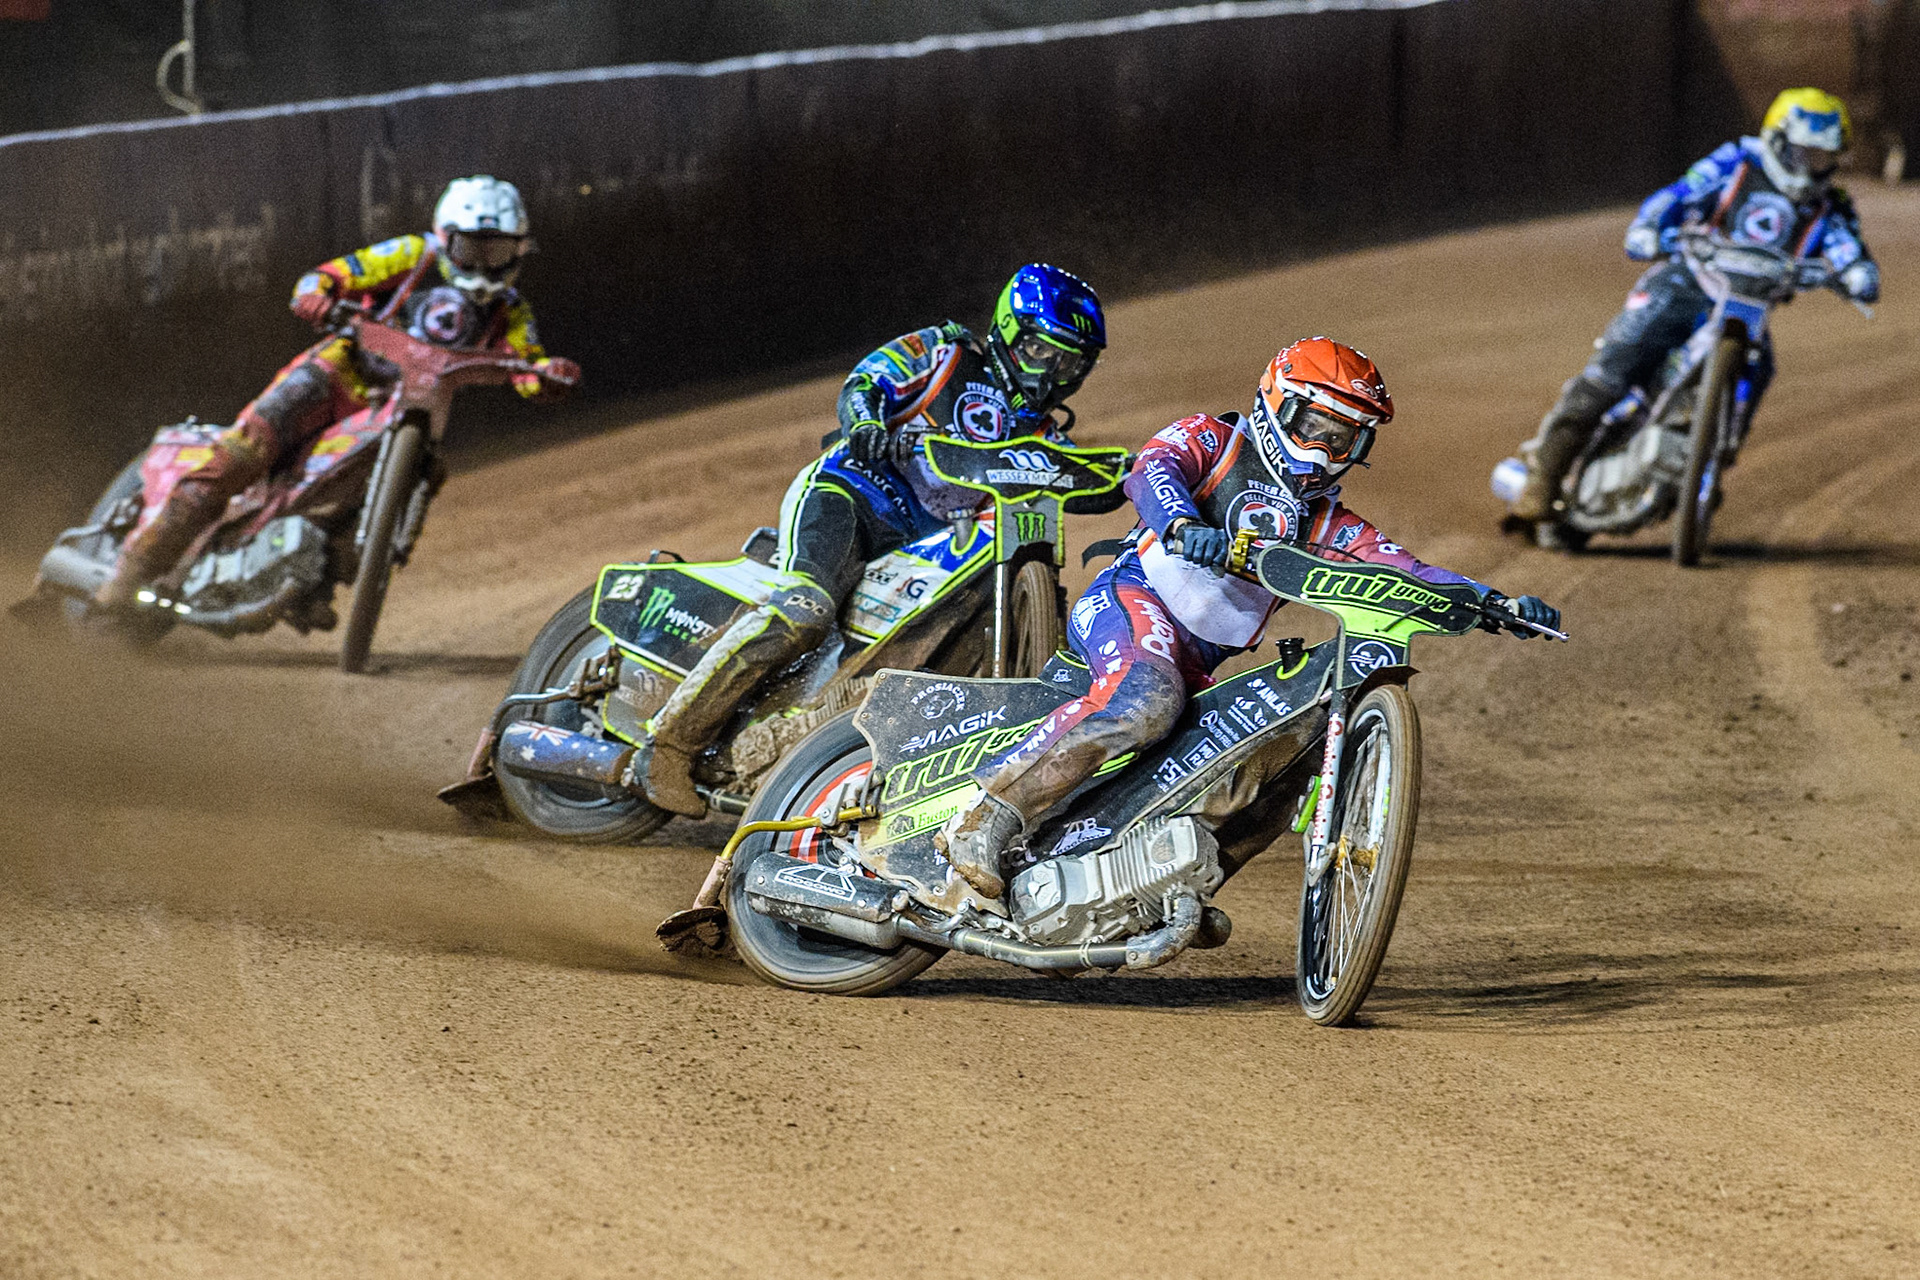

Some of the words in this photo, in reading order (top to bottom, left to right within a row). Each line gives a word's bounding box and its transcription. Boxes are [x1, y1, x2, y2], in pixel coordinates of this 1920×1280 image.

[1248, 480, 1278, 497] PETER
[1243, 494, 1268, 504] BELLE
[1271, 500, 1289, 512] VUE
[604, 573, 646, 602] 23
[665, 607, 718, 636] MONST
[1256, 686, 1292, 716] ANLAS
[917, 806, 959, 828] Euston
[783, 874, 847, 896] ROGOWO
